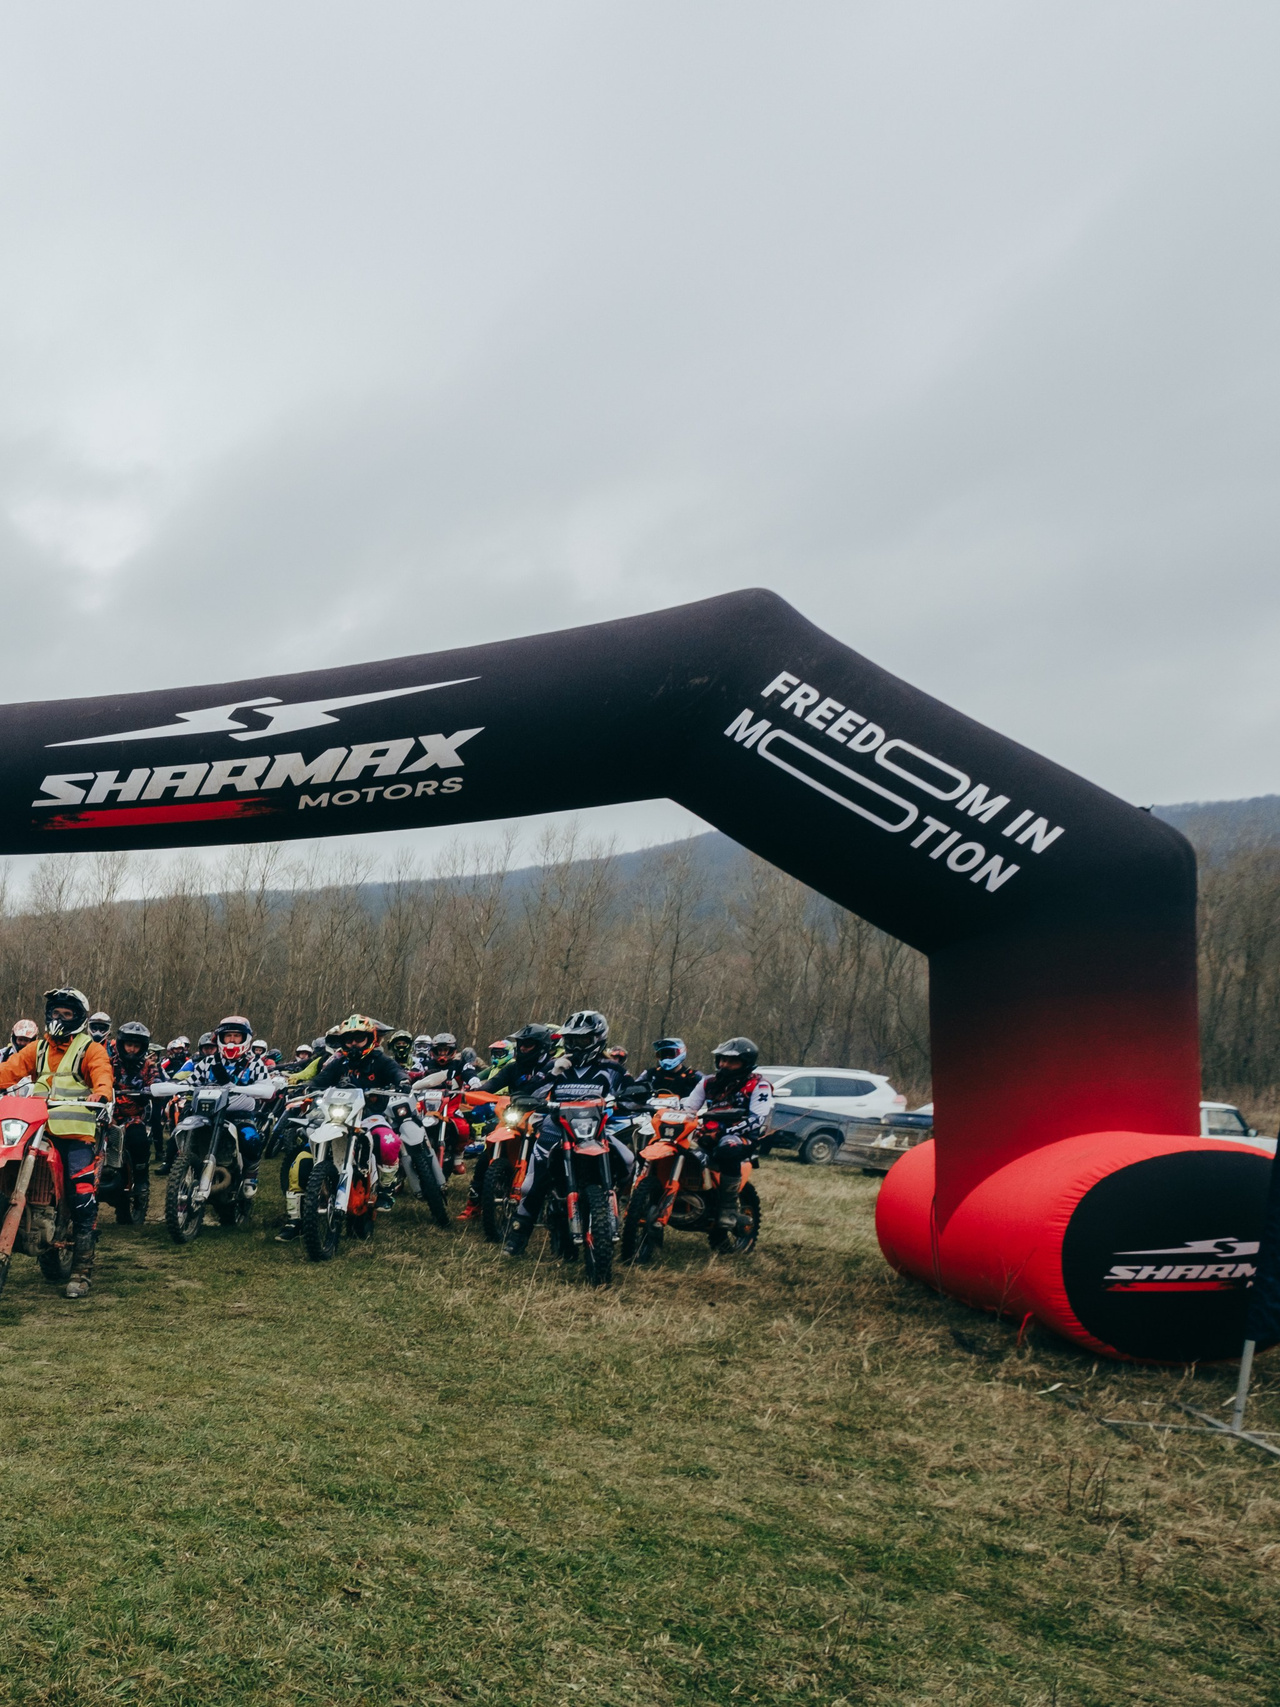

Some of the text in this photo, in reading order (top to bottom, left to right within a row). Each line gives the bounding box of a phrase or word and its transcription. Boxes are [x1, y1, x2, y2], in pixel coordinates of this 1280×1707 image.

[31, 726, 486, 807] SHARMAX
[298, 776, 464, 810] MOTORS
[724, 708, 1020, 893] MOTION
[760, 671, 1065, 854] FREEDOM IN
